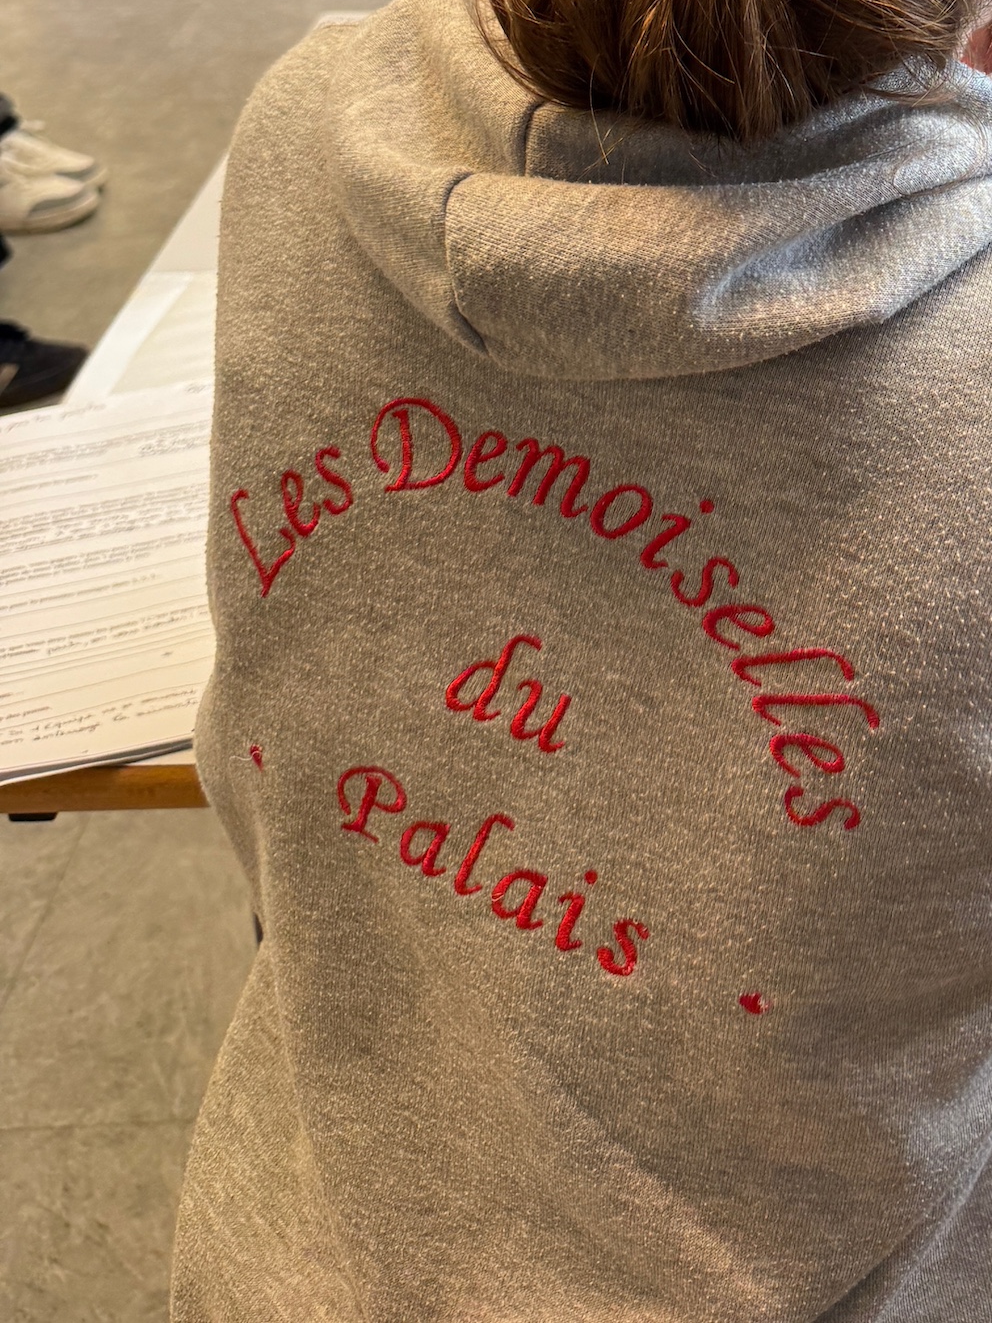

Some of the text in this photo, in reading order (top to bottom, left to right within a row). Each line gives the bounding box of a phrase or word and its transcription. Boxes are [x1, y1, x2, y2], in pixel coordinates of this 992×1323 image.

[231, 446, 352, 596] Les
[370, 398, 879, 829] Demoiselles
[445, 635, 571, 753] du
[337, 767, 649, 977] Palais
